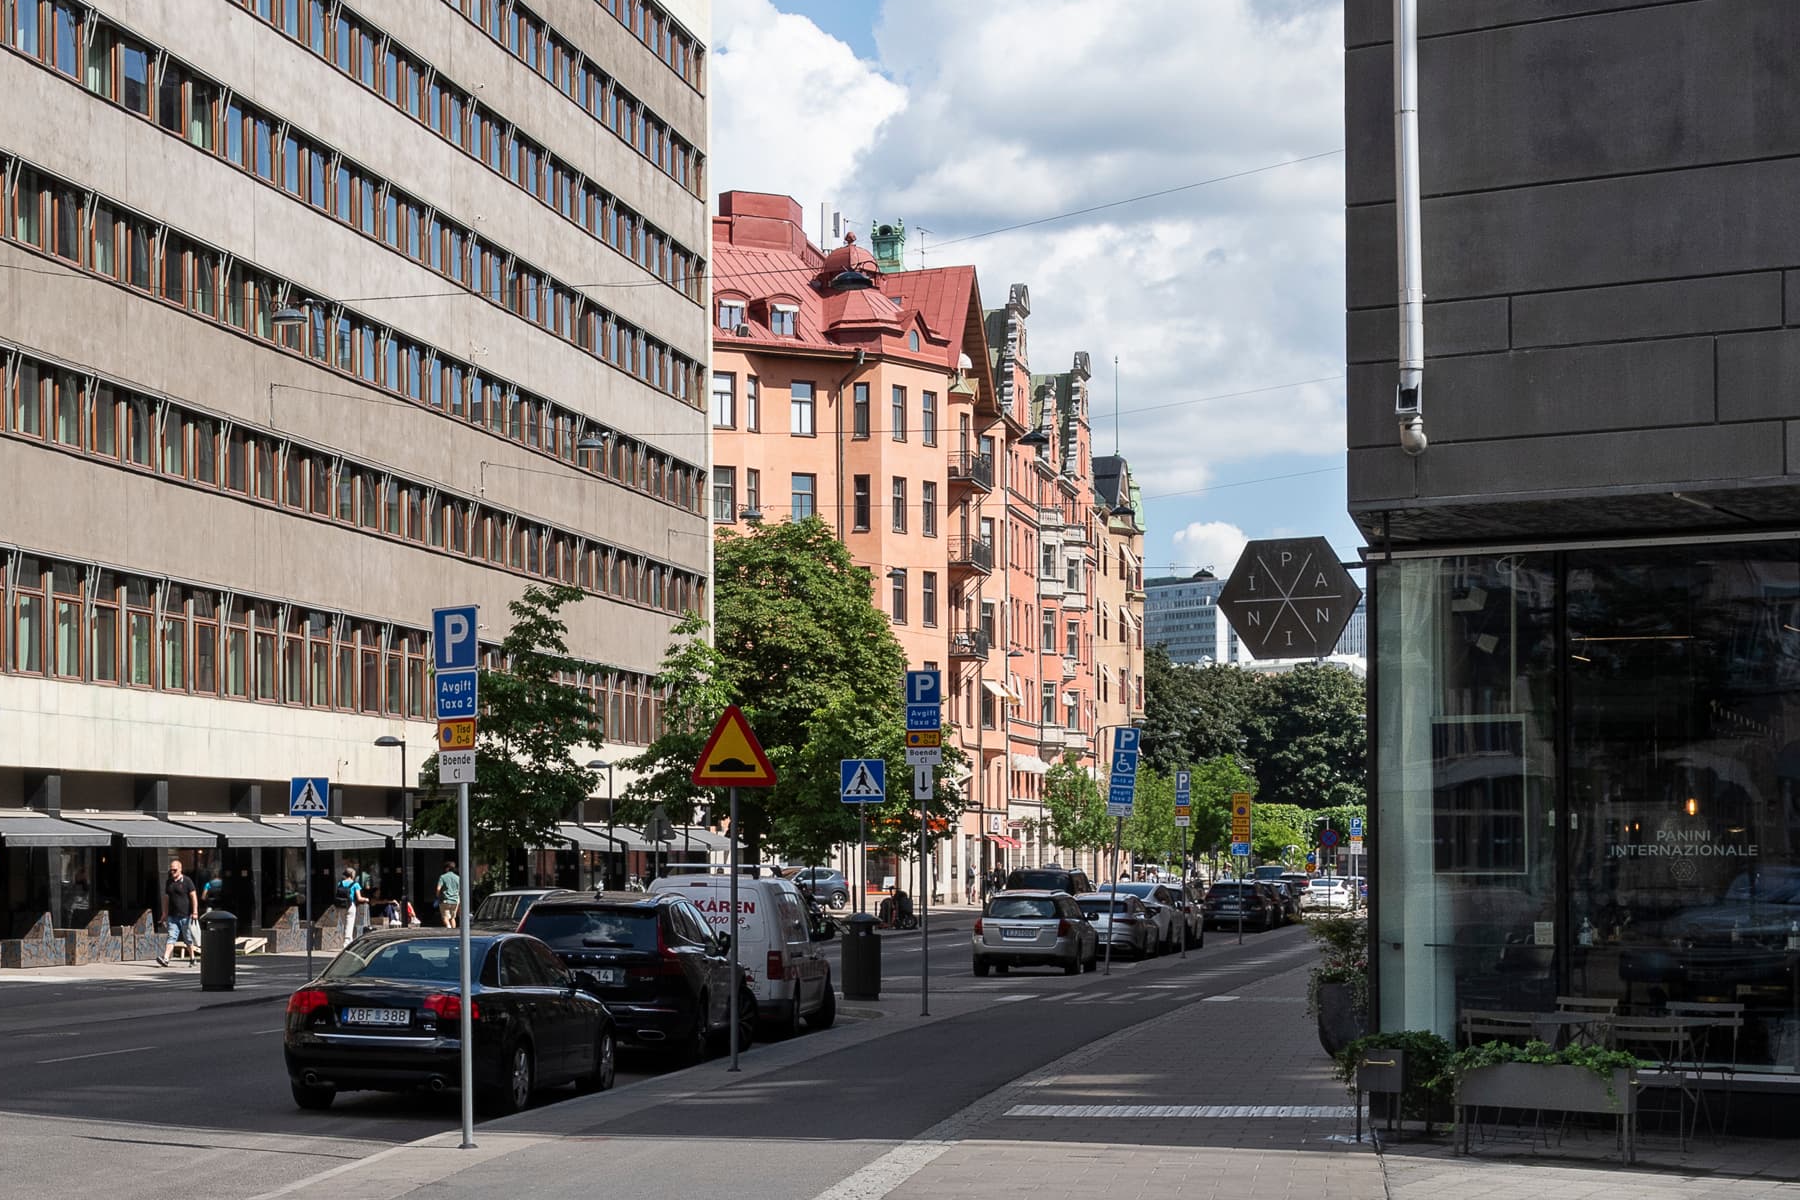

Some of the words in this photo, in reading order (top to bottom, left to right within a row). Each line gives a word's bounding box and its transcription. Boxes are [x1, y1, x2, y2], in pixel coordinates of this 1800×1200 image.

[444, 613, 469, 664] P
[442, 679, 471, 695] Avgift
[915, 674, 935, 701] P
[440, 698, 463, 710] Taxa
[466, 696, 473, 708] 2
[911, 710, 936, 718] Avgift
[456, 724, 471, 734] Tisd
[456, 734, 470, 744] 0-6
[1121, 730, 1135, 748] P
[443, 754, 471, 766] Boende
[453, 768, 461, 780] Ci
[1179, 774, 1188, 789] P
[1656, 830, 1711, 842] PANINI
[1611, 844, 1758, 856] INTERNAZIONALE
[350, 1009, 373, 1021] XBF
[383, 1010, 407, 1022] 38B
